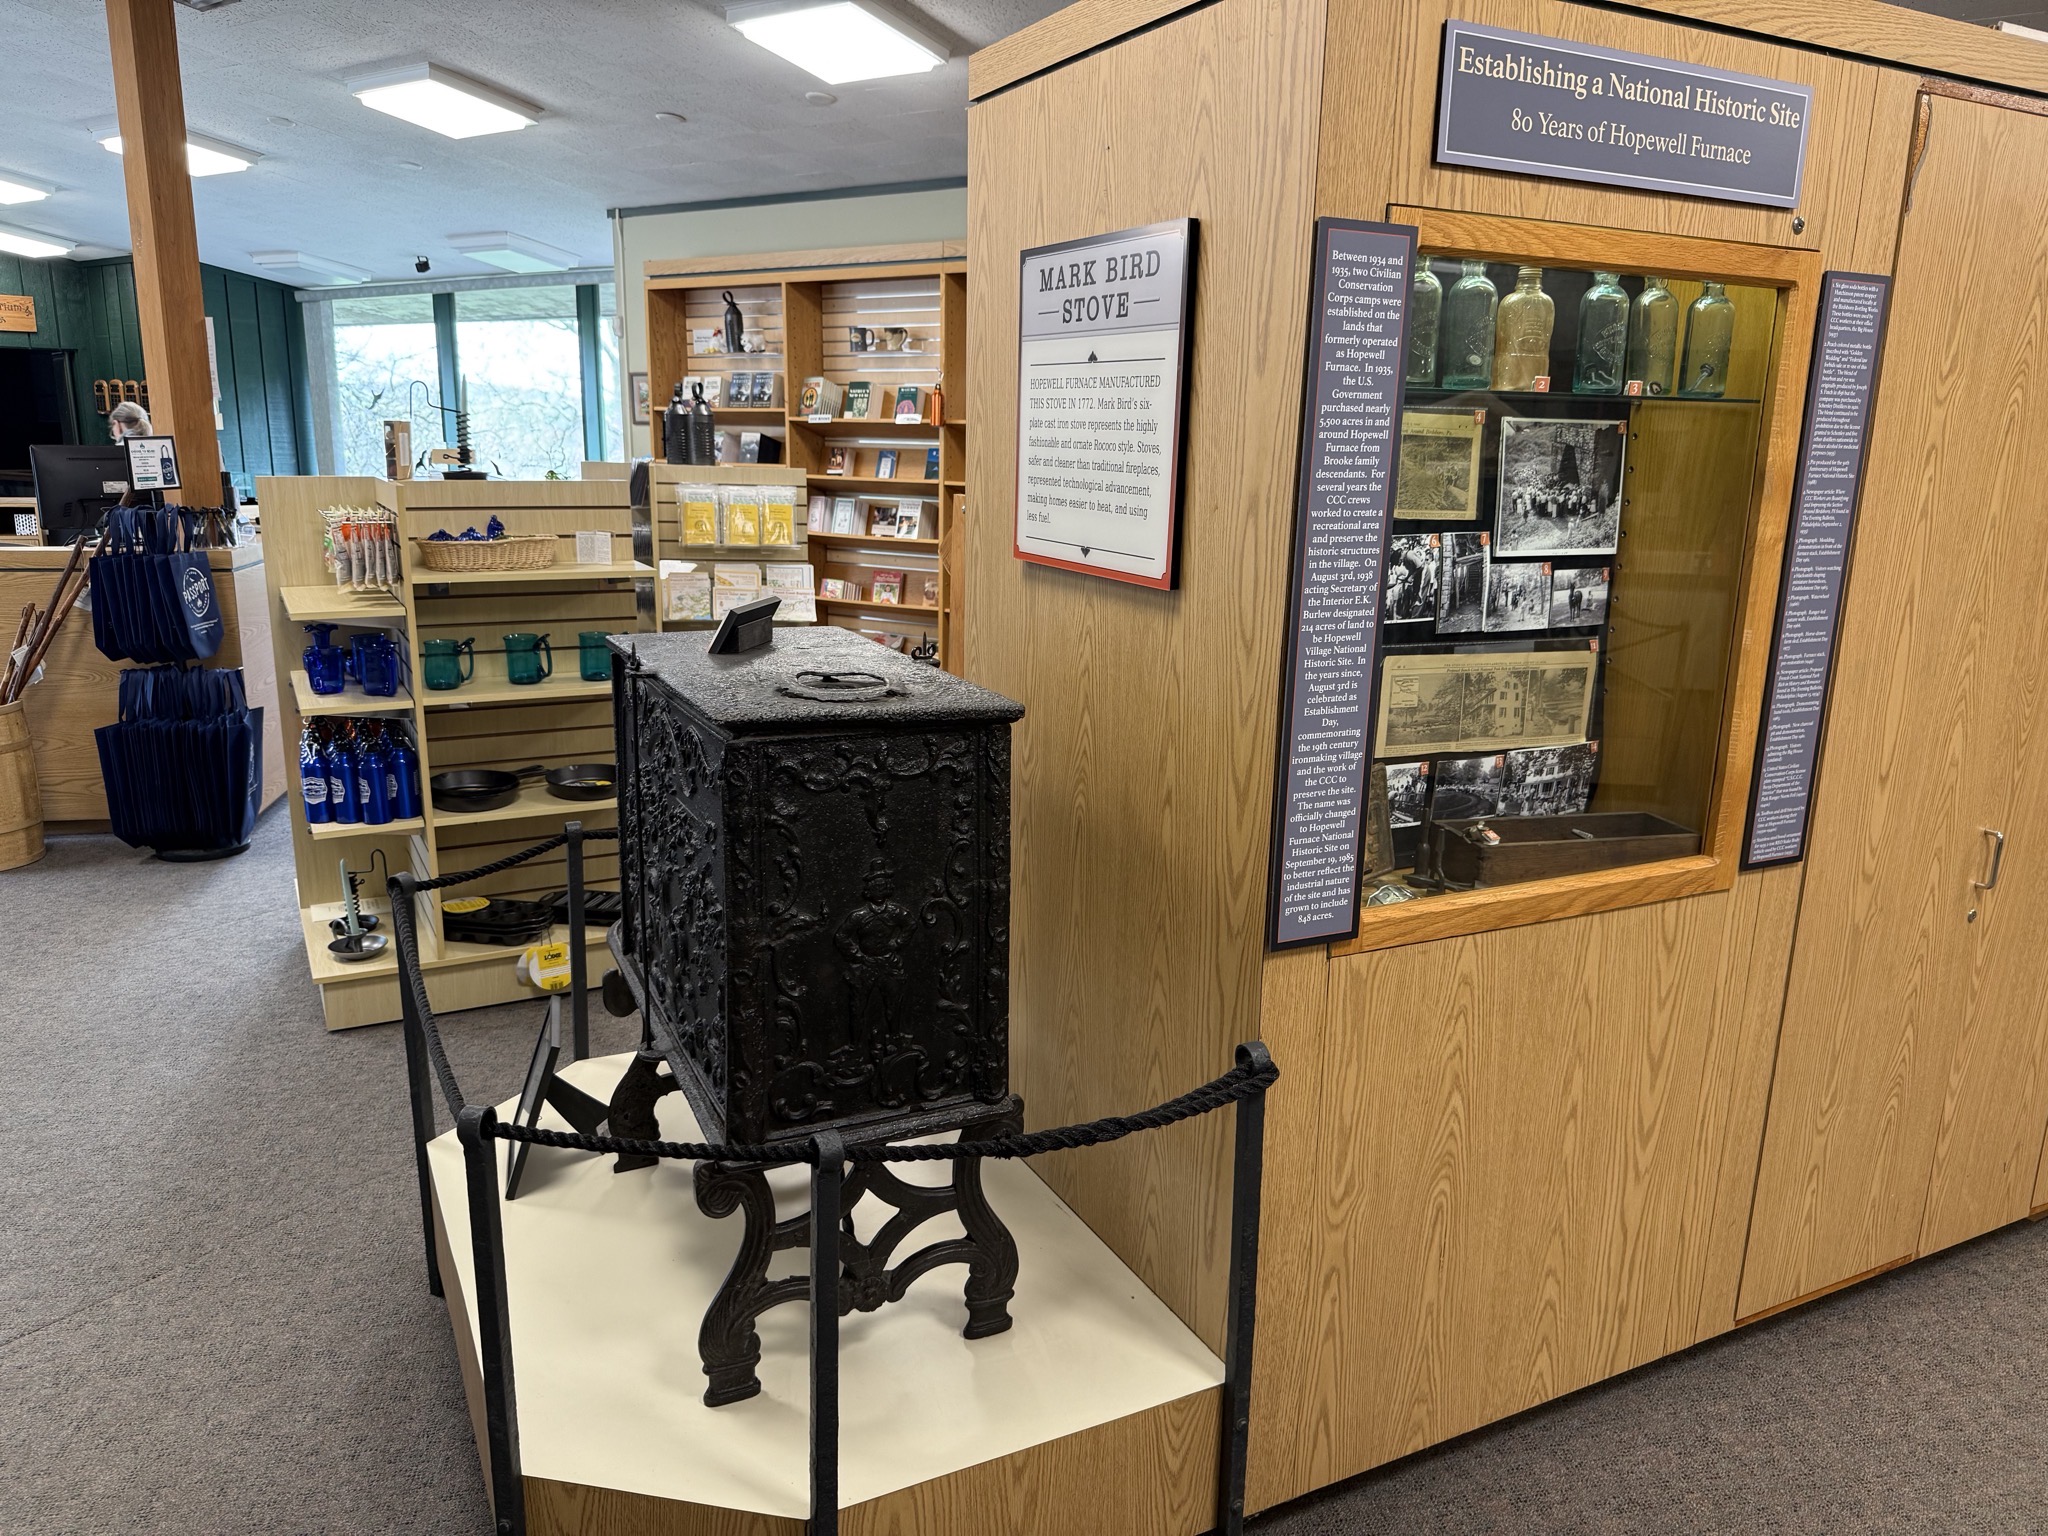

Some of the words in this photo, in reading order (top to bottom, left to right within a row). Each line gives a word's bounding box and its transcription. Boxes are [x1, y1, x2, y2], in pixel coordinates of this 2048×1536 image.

[1458, 46, 1587, 98] Establishing
[1592, 77, 1602, 96] a
[1608, 73, 1690, 110] National
[1694, 88, 1766, 123] Historic
[1769, 102, 1800, 129] Site
[1511, 108, 1533, 132] 80
[1537, 112, 1583, 139] Years
[1588, 122, 1607, 142] of
[1610, 123, 1686, 155] Hopewell
[1690, 136, 1751, 164] Furnace
[1332, 250, 1367, 263] Between
[1369, 256, 1385, 266] 1934
[1388, 256, 1403, 265] and
[1040, 260, 1096, 292] MARK
[1105, 250, 1160, 282] BIRD
[1332, 266, 1350, 277] 1935,
[1353, 268, 1368, 276] two
[1370, 268, 1401, 279] Civilian
[1339, 279, 1393, 292] Conservation
[1328, 292, 1353, 305] Corps
[1355, 296, 1380, 307] camps
[1383, 298, 1401, 306] were
[1063, 292, 1129, 324] STOVE
[1327, 307, 1372, 318] established
[1387, 311, 1400, 319] the
[1343, 321, 1364, 331] lands
[1367, 322, 1382, 332] that
[1325, 334, 1360, 347] formerly
[1363, 338, 1398, 348] operated
[1336, 350, 1344, 358] as
[1347, 349, 1385, 361] Hopewell
[1325, 362, 1360, 372] Furnace.
[1365, 363, 1373, 372] In
[1375, 366, 1393, 375] 1935,
[1031, 378, 1064, 389] HOPEWELL
[1066, 377, 1097, 389] FURNACE
[1099, 375, 1161, 389] MANUFACTURED
[1343, 376, 1356, 385] the
[1358, 377, 1373, 386] U.S.
[1332, 389, 1382, 399] Government
[1030, 398, 1044, 409] THIS
[1046, 398, 1067, 409] STOVE
[1068, 398, 1076, 409] IN
[1078, 398, 1096, 409] 1772.
[1097, 398, 1115, 410] Mark
[1117, 398, 1137, 410] Bird's
[1140, 399, 1152, 410] six-
[1321, 403, 1363, 414] purchased
[1366, 404, 1390, 415] nearly
[1029, 418, 1043, 430] plate
[1044, 419, 1056, 428] cast
[1057, 419, 1069, 429] iron
[1071, 420, 1086, 430] stove
[1088, 420, 1122, 432] represents
[1123, 420, 1134, 431] the
[1136, 420, 1158, 434] highly
[1319, 430, 1348, 439] around
[1351, 430, 1389, 441] Hopewell
[1029, 436, 1059, 448] fashionable
[1061, 438, 1071, 449] and
[1073, 440, 1092, 450] ornate
[1094, 440, 1116, 451] Rococo
[1118, 441, 1135, 455] style.
[1137, 441, 1161, 455] Stoves,
[1028, 457, 1042, 467] safer
[1043, 458, 1053, 467] and
[1054, 458, 1075, 469] cleaner
[1077, 459, 1090, 470] than
[1092, 460, 1124, 473] traditional
[1126, 461, 1160, 477] fireplaces,
[1324, 456, 1353, 465] Brooke
[1355, 456, 1380, 467] family
[1316, 469, 1367, 478] descendants.
[1371, 469, 1385, 478] For
[1028, 475, 1061, 487] represented
[1063, 477, 1103, 493] technological
[1105, 481, 1151, 498] advancement,
[1327, 495, 1346, 504] CCC
[1027, 493, 1047, 507] making
[1049, 496, 1068, 507] homes
[1069, 499, 1088, 509] easier
[1089, 501, 1095, 511] to
[1097, 501, 1113, 513] heat,
[1115, 503, 1127, 515] and
[1129, 506, 1148, 520] using
[1027, 511, 1037, 522] less
[1039, 513, 1051, 524] fuel.
[1313, 521, 1361, 530] recreational
[1308, 547, 1338, 556] historic
[1340, 547, 1380, 555] structures
[1311, 572, 1338, 583] August
[1340, 572, 1355, 582] 3rd,
[1357, 571, 1373, 580] 1938
[183, 577, 209, 602] PASSPORT
[1303, 610, 1331, 619] Burlew
[1333, 607, 1375, 619] designated
[1305, 647, 1331, 657] Village
[1334, 644, 1367, 654] National
[1304, 659, 1336, 668] Historic
[1338, 657, 1353, 666] Site.
[1358, 656, 1366, 664] In
[1307, 693, 1347, 704] celebrated
[1304, 705, 1358, 716] Establishment
[1322, 718, 1339, 727] Day,
[1298, 728, 1361, 740] commemorating
[1299, 744, 1310, 752] the
[1313, 742, 1327, 753] 19th
[1330, 741, 1359, 749] century
[1292, 754, 1337, 764] ironmaking
[1338, 751, 1363, 760] village
[1293, 789, 1326, 802] preserve
[1328, 787, 1339, 796] the
[1290, 812, 1323, 823] officially
[1325, 808, 1356, 818] changed
[1289, 836, 1320, 845] Furnace
[1322, 830, 1354, 841] National
[1286, 858, 1325, 870] September
[1328, 856, 1337, 864] 19,
[1339, 853, 1354, 861] 1985
[1287, 880, 1323, 891] industrial
[1325, 876, 1349, 886] nature
[1298, 914, 1311, 924] 848
[1312, 912, 1333, 920] acres.
[544, 952, 562, 960] LODGE
